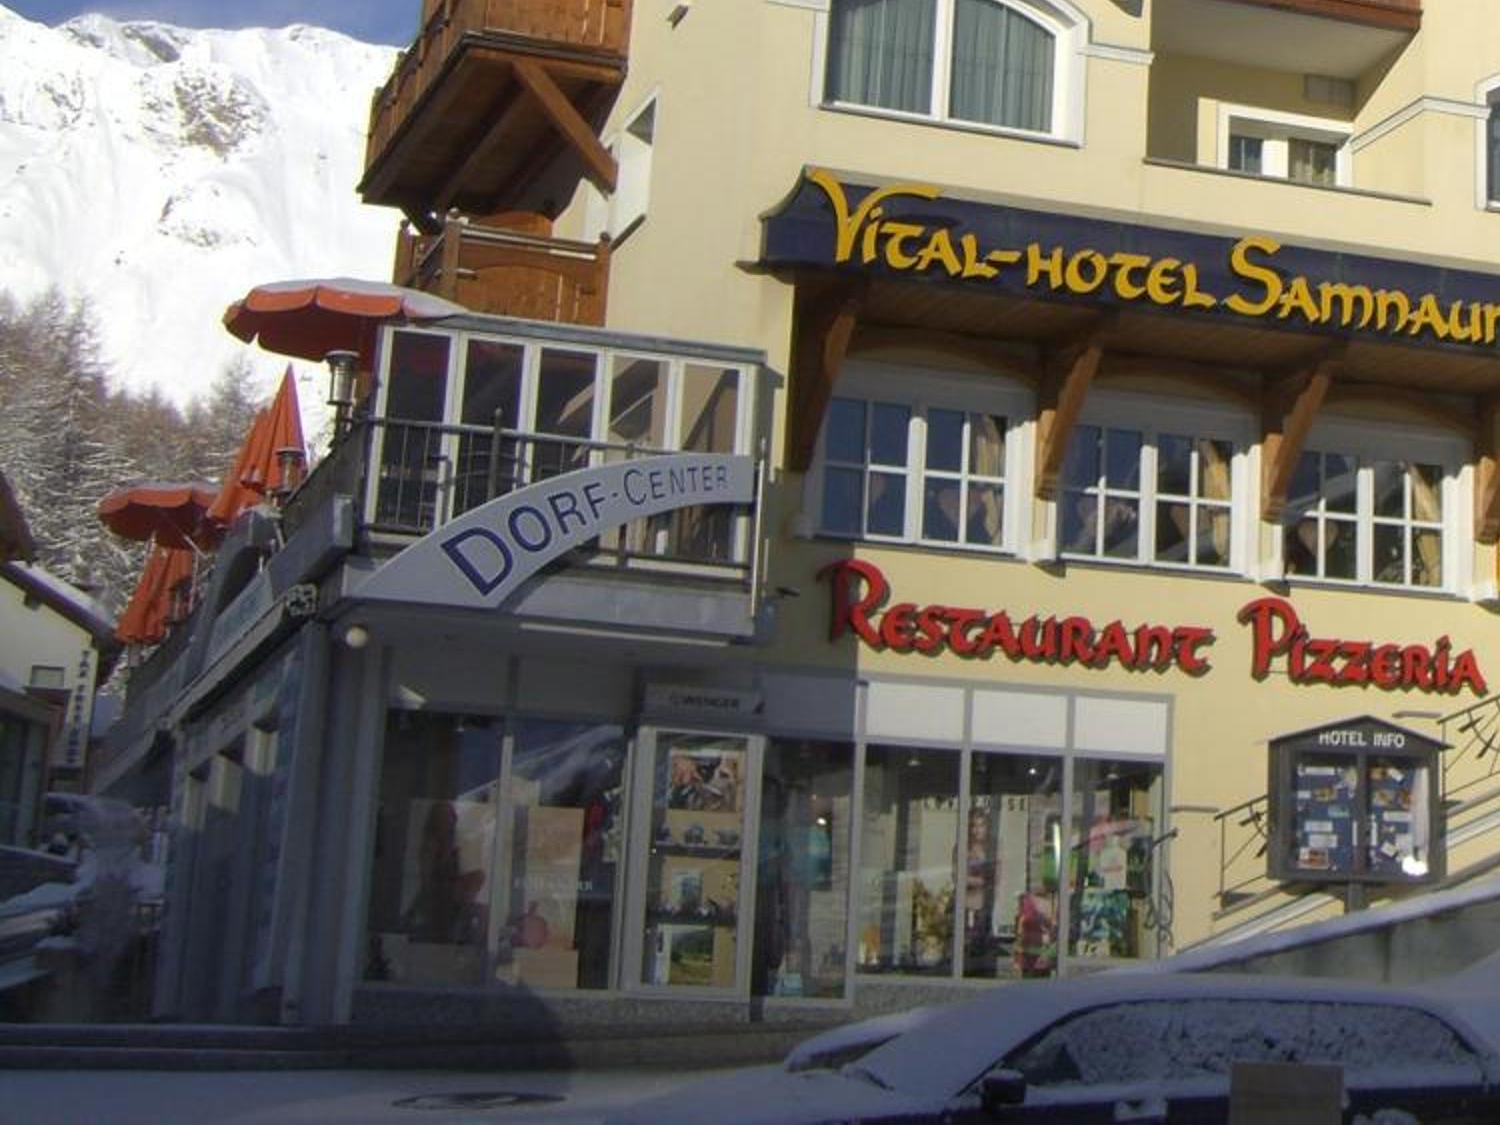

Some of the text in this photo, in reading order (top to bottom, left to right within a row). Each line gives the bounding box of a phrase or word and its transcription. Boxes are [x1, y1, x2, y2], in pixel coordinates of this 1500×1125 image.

[811, 169, 1217, 308] VITAL-HOTEL
[820, 558, 1488, 695] RESTAURANT PIZZERIA
[1318, 730, 1406, 748] HOTEL INFO
